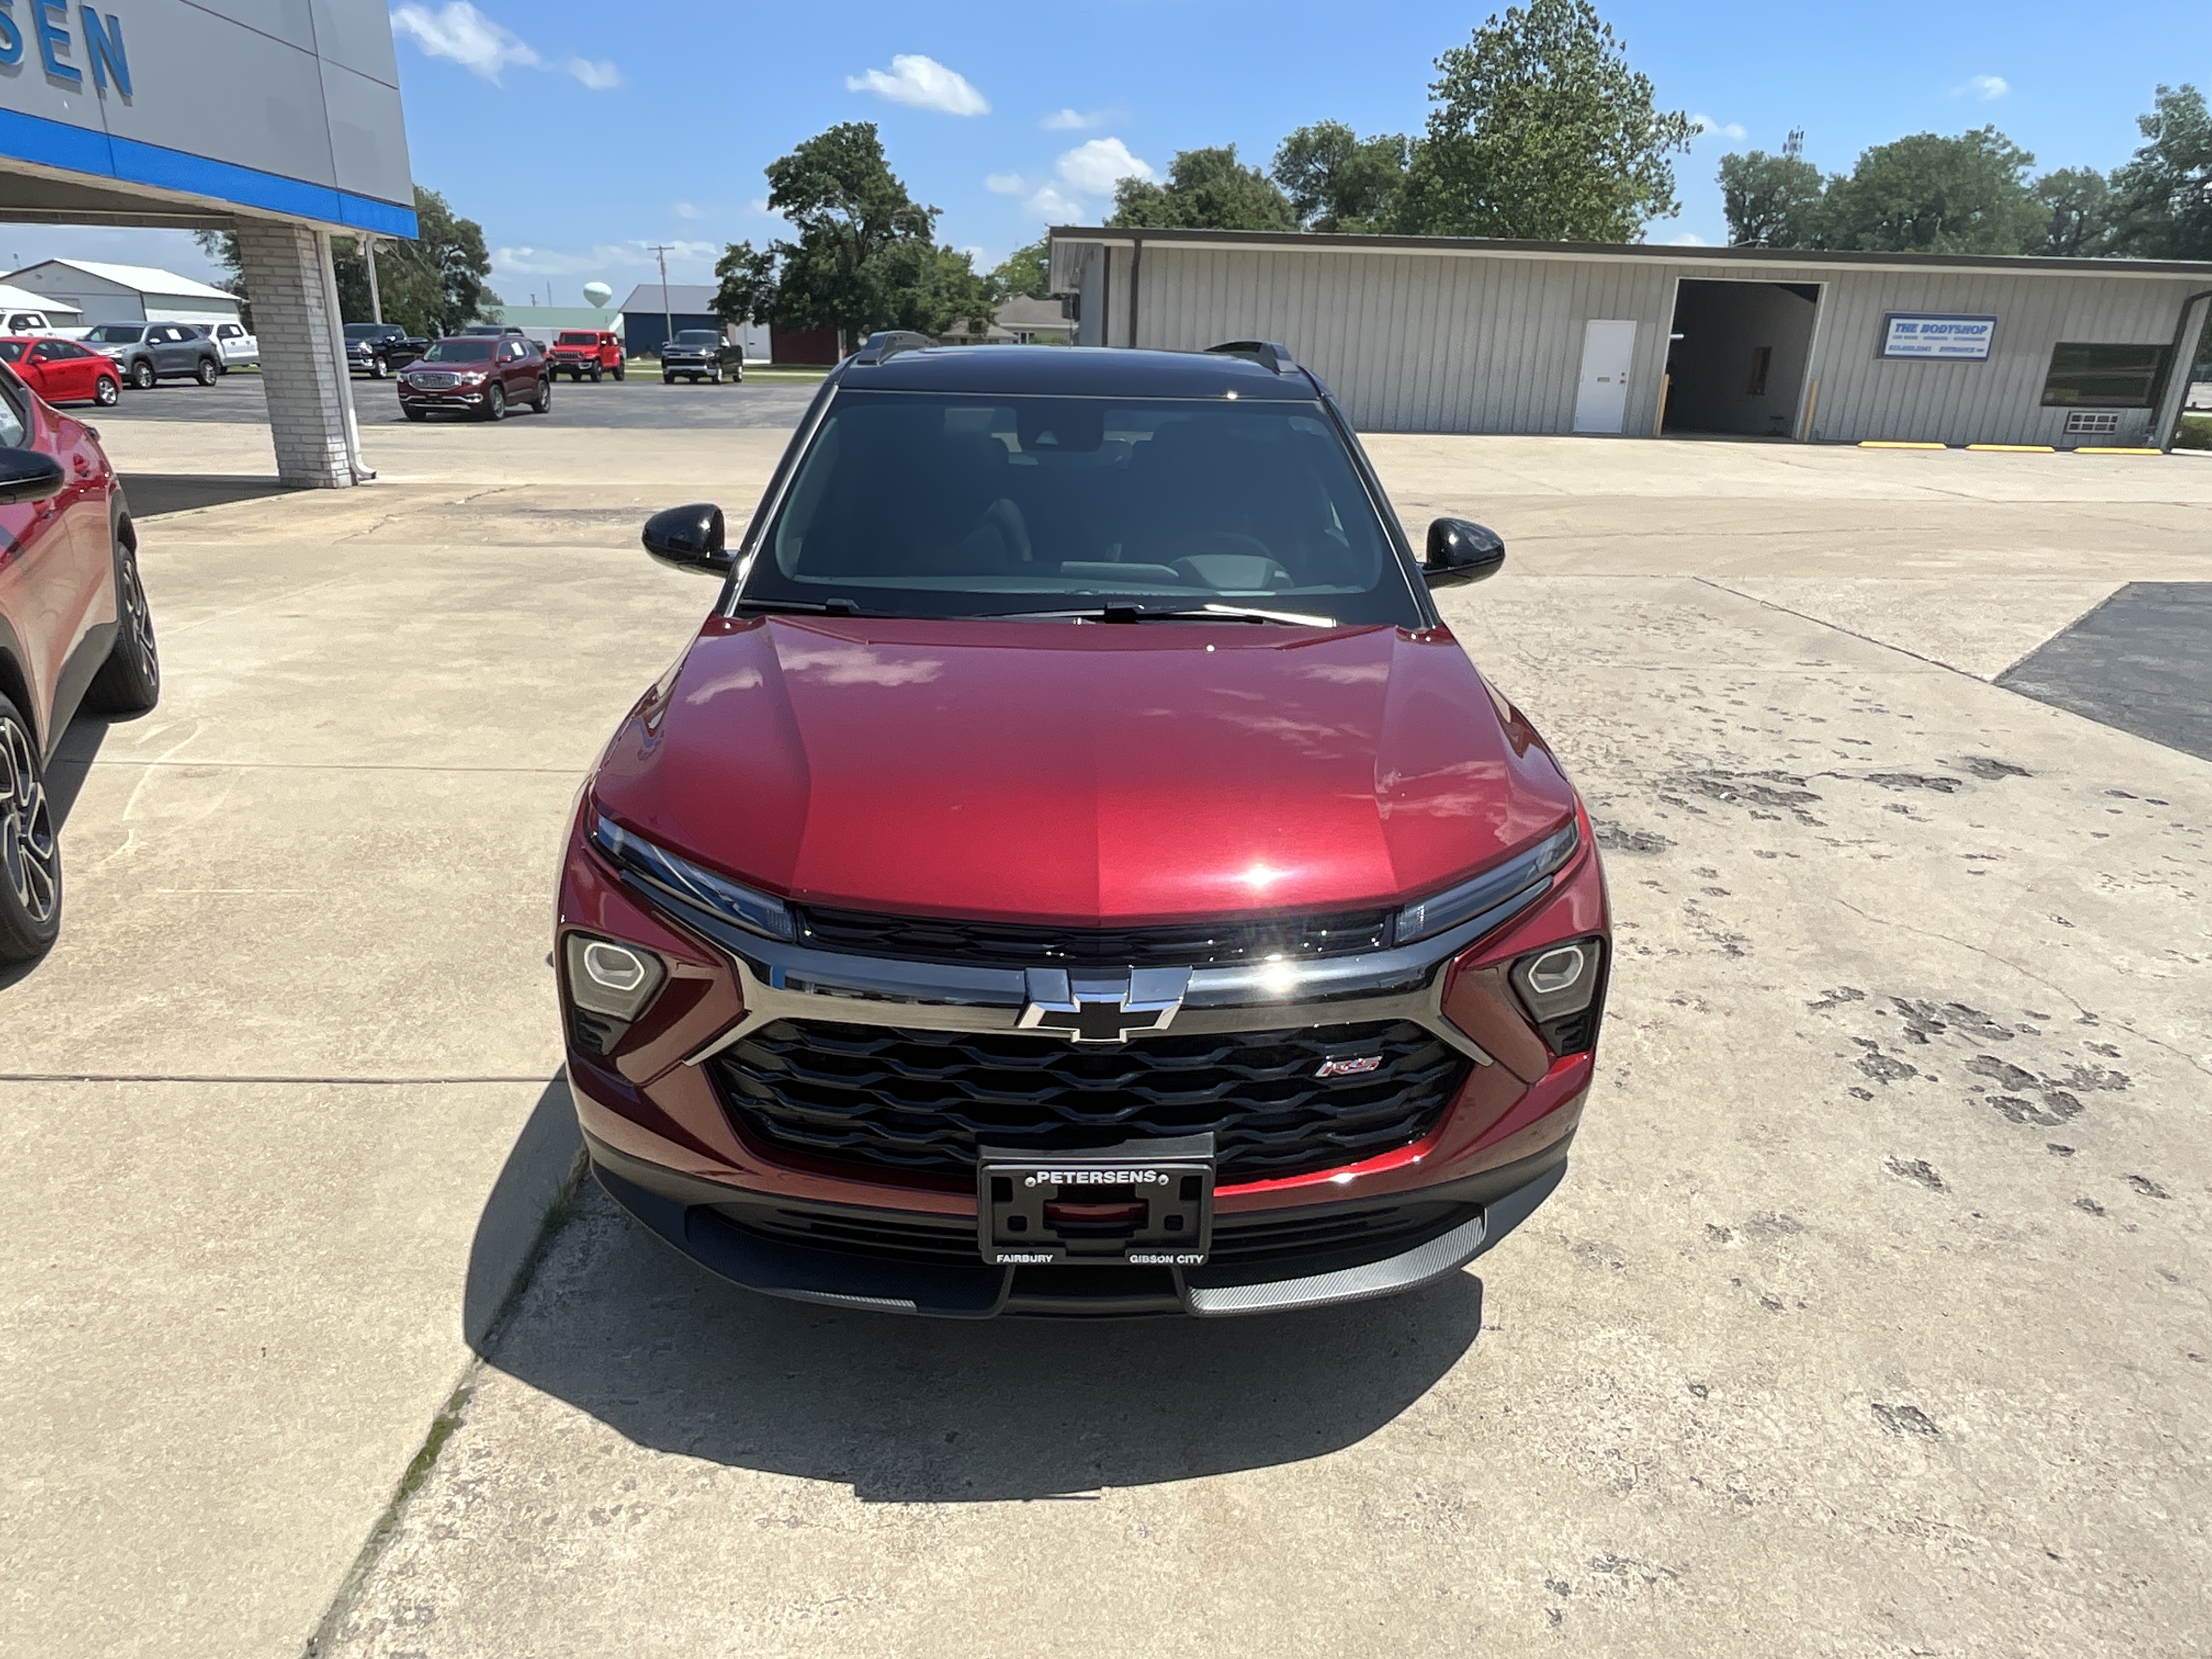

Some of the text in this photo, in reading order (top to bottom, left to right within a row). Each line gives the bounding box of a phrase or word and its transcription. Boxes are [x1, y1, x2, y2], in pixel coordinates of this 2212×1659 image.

[1895, 323, 1988, 334] THE BODYSHOP
[1314, 1056, 1383, 1077] RS
[1036, 1170, 1156, 1184] PETERSENS
[996, 1254, 1053, 1263] FAIRBURY
[1129, 1254, 1204, 1263] GIBSON CITY
